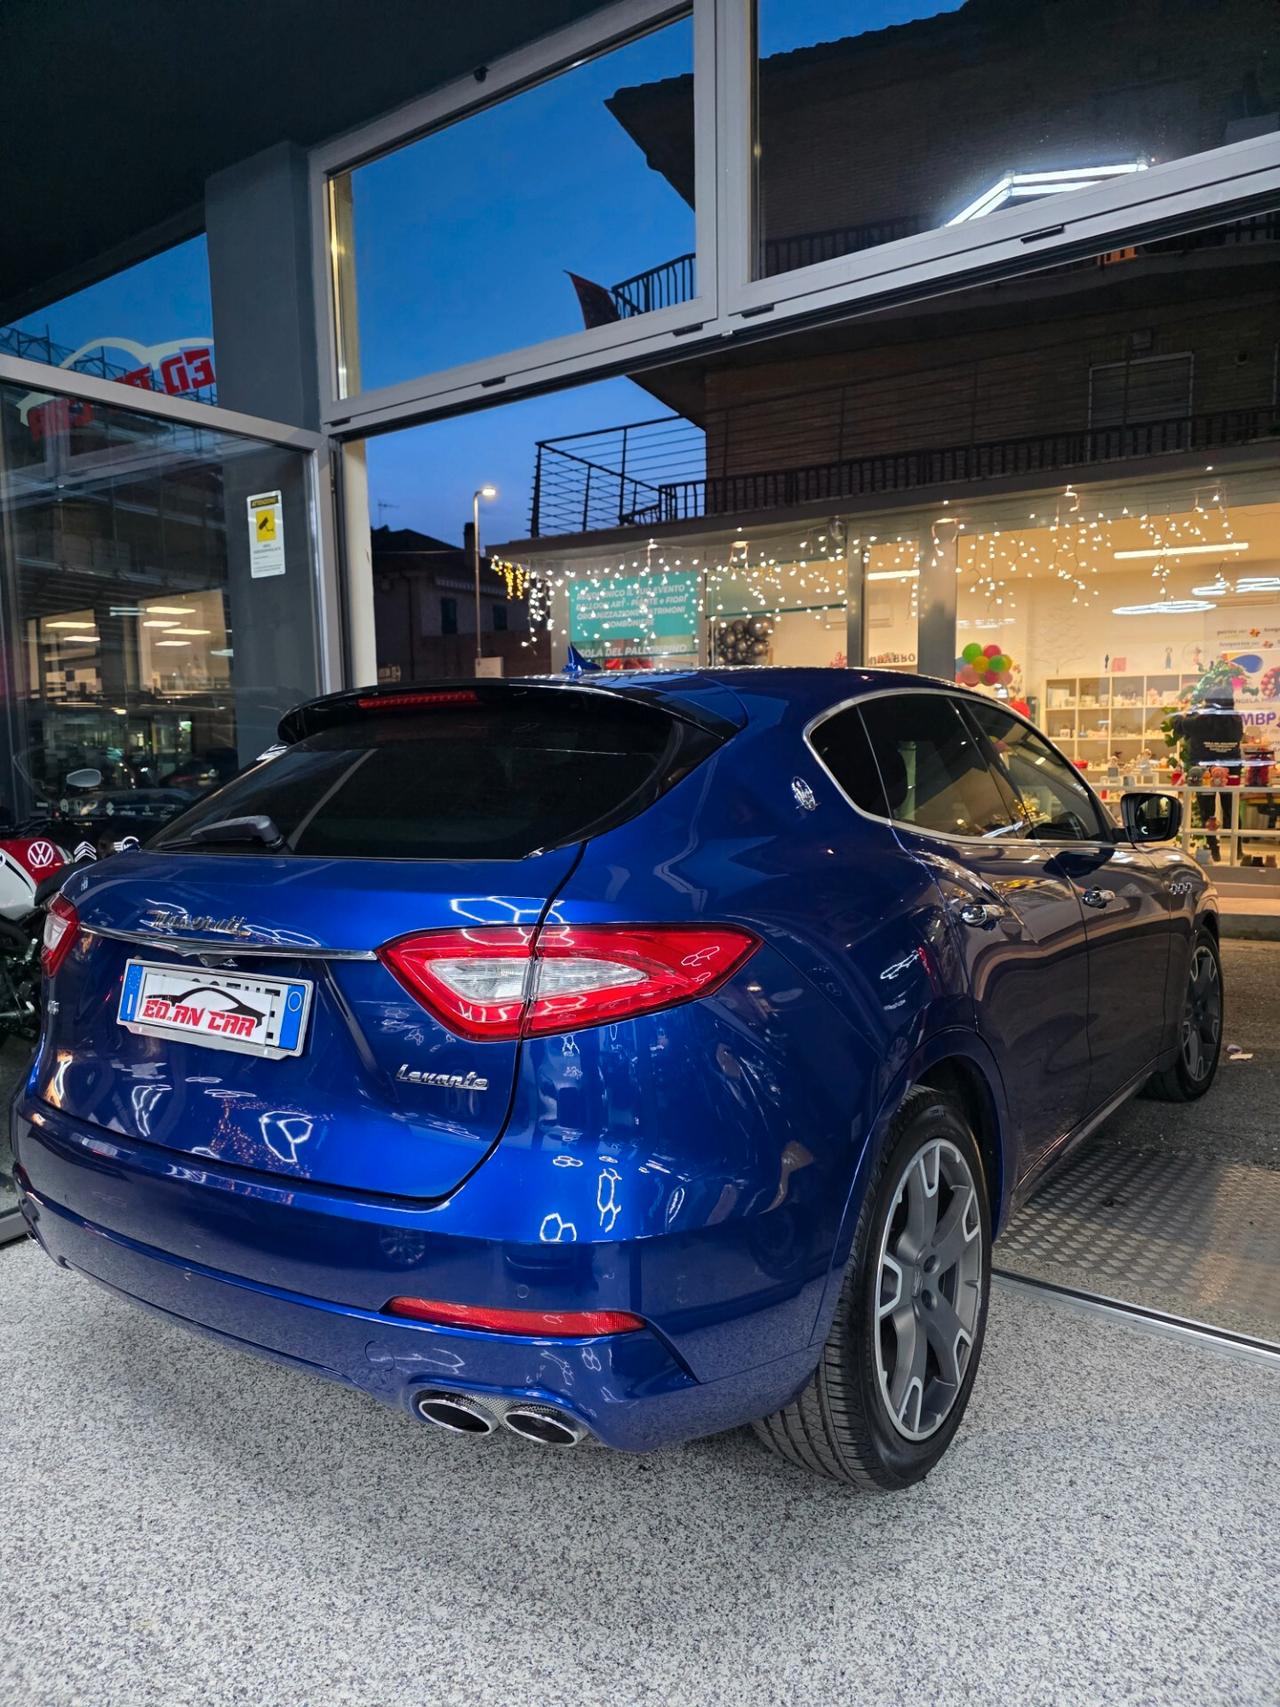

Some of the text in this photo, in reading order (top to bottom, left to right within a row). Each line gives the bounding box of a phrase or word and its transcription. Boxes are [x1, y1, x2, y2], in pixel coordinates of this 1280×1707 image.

[653, 584, 685, 593] EVENTO
[665, 595, 688, 603] FIORI
[605, 646, 624, 656] DEL
[207, 1010, 256, 1038] CAR
[396, 1063, 488, 1091] Levante
